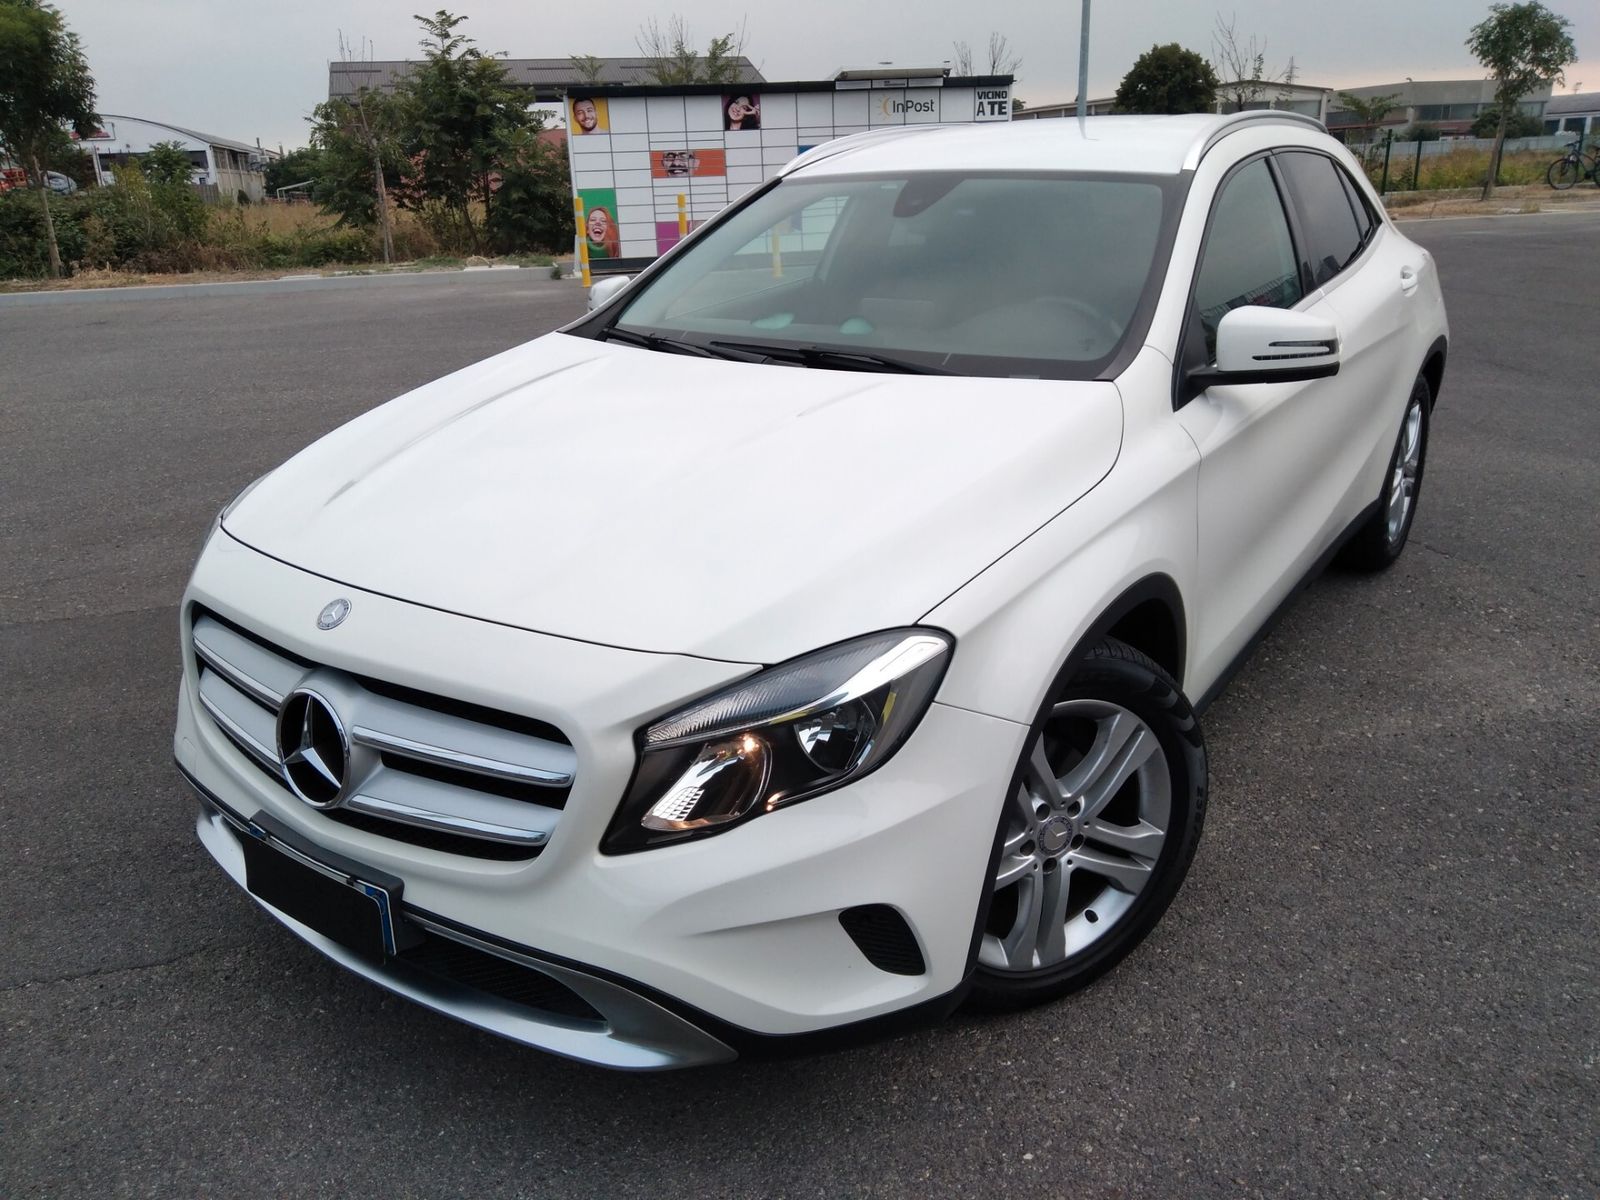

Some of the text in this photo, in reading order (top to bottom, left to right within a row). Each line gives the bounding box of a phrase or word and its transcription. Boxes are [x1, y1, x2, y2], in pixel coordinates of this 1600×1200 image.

[977, 90, 1008, 100] VICINO
[892, 99, 935, 113] InPost
[976, 101, 1008, 116] A TE
